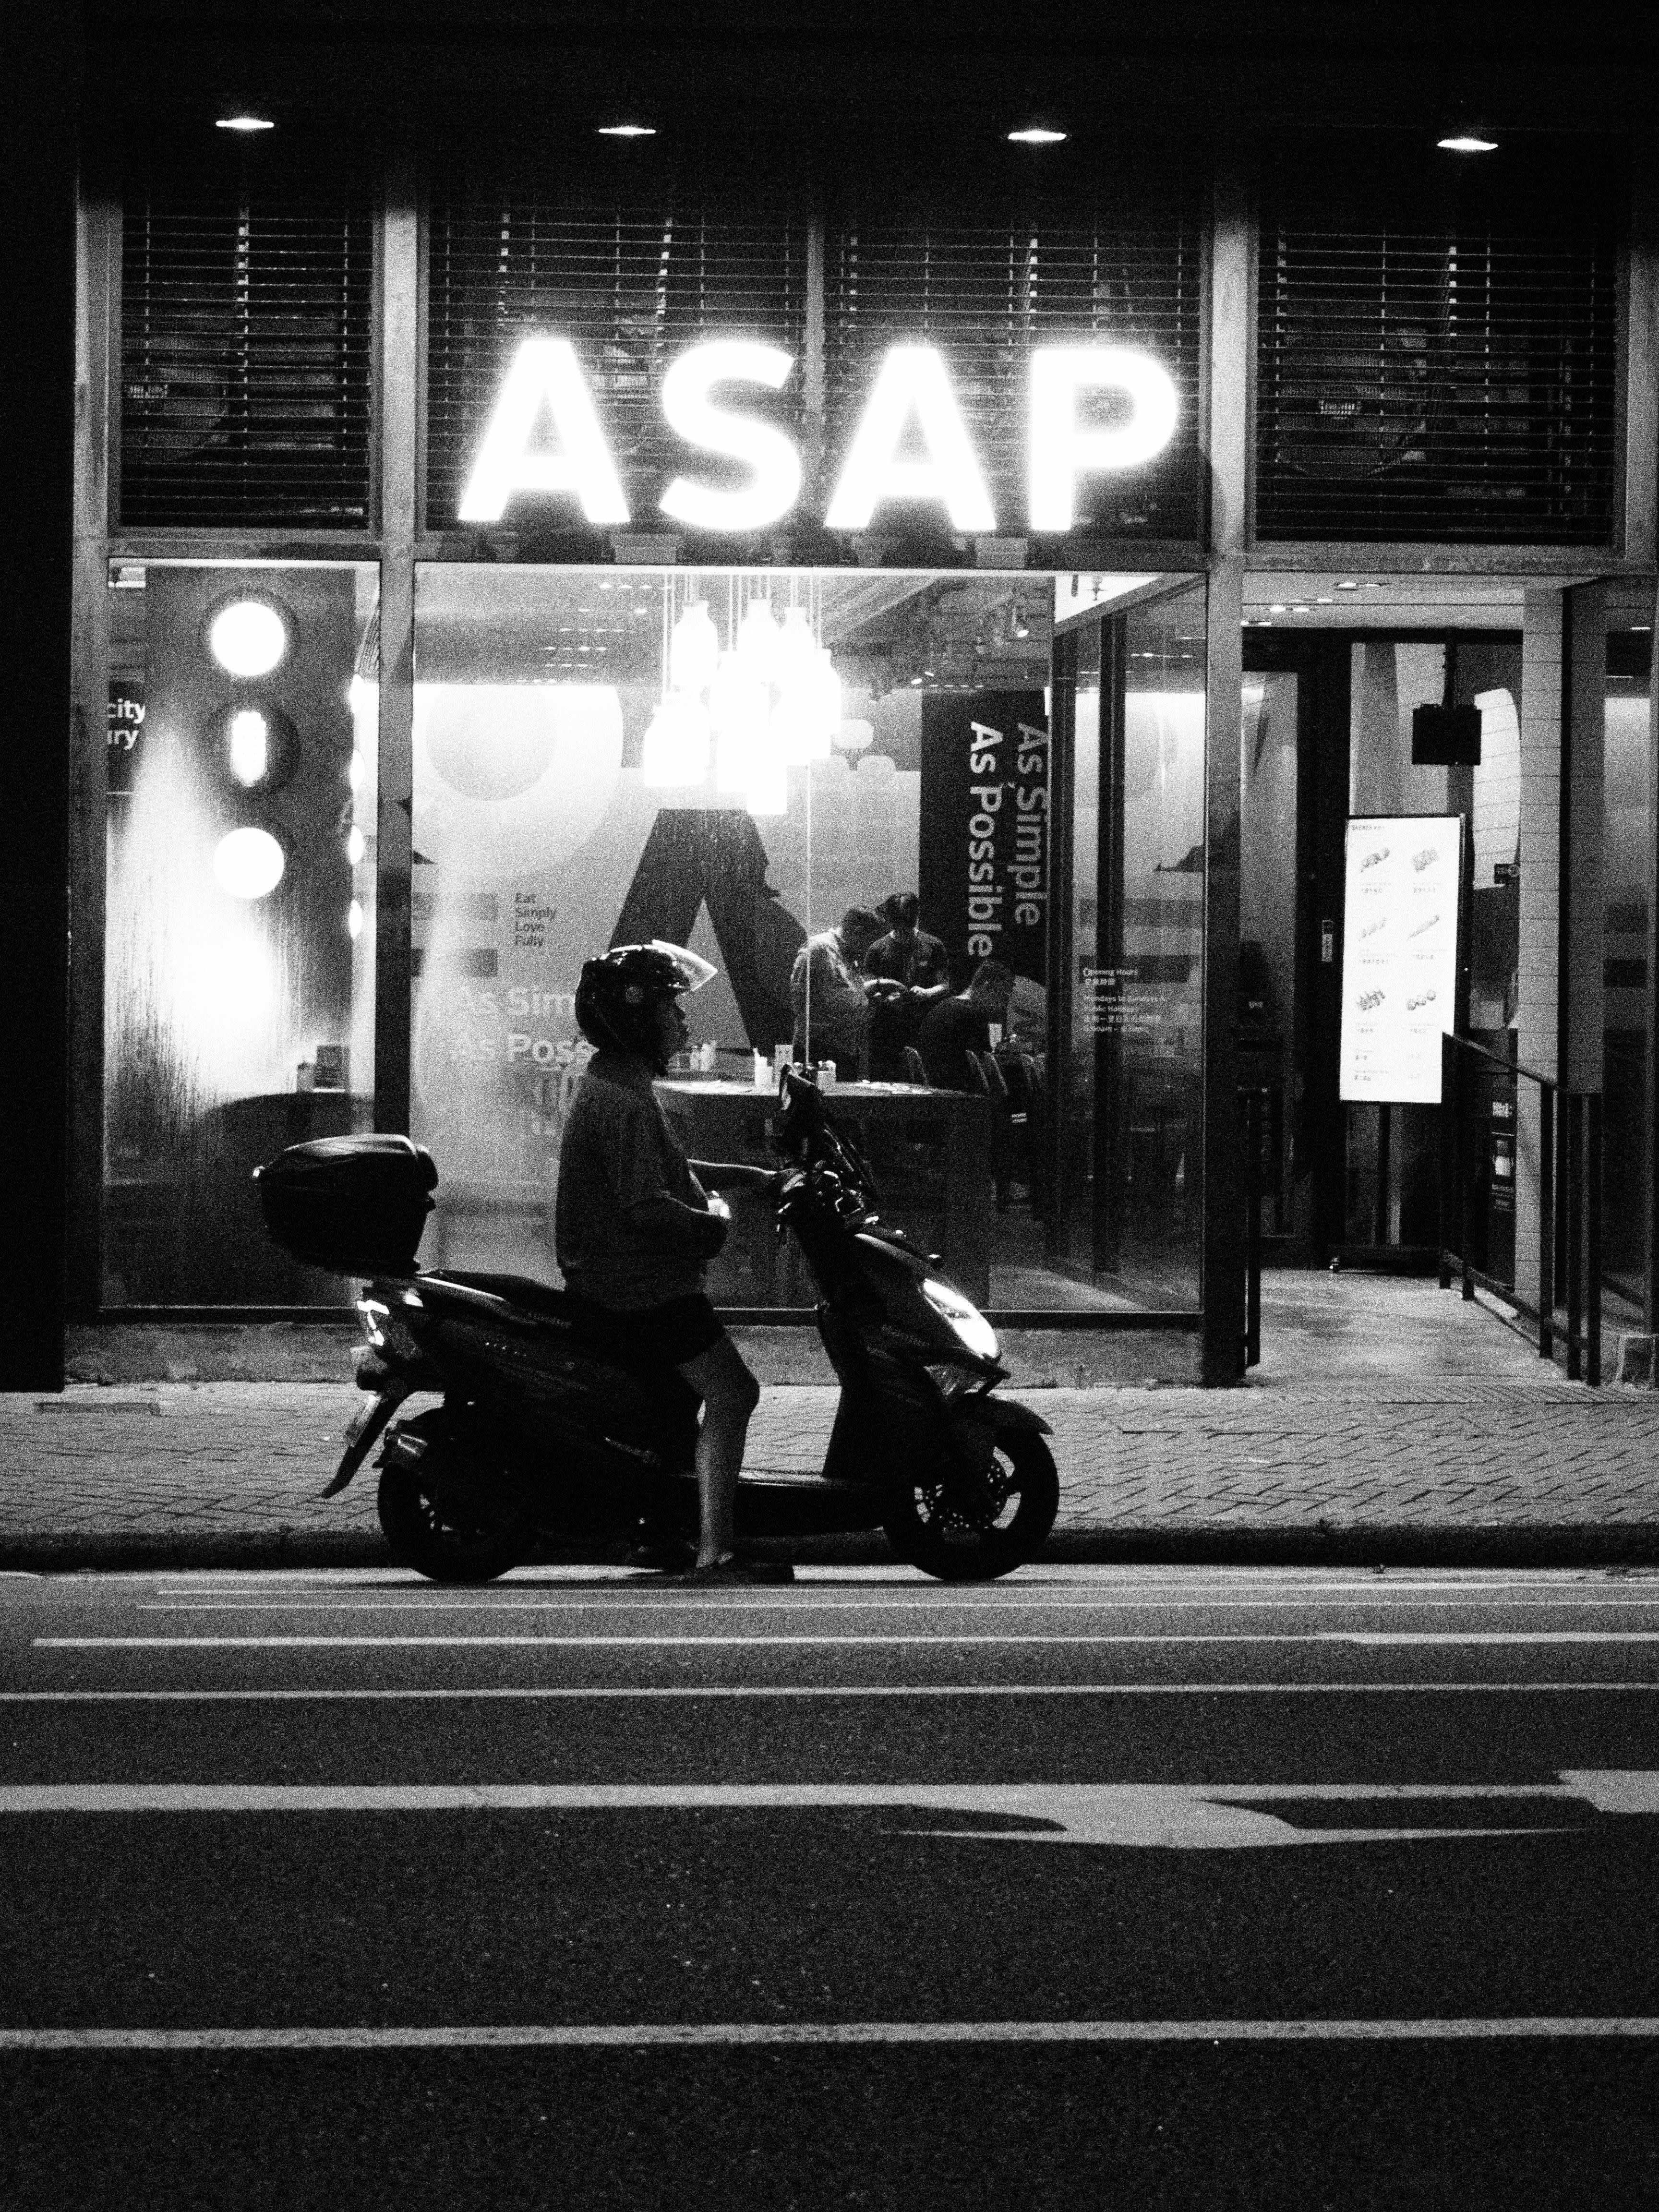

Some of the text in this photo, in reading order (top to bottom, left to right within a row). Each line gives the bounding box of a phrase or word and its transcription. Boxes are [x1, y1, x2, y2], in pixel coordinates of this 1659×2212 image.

[457, 338, 1179, 531] ASAP
[107, 697, 146, 724] city
[1008, 722, 1048, 927] As Simple
[967, 721, 1004, 959] As Possible
[515, 892, 537, 904] Eat
[515, 906, 557, 921] Simply
[515, 921, 545, 932] Love
[515, 935, 544, 949] Fully
[1082, 967, 1115, 977] Opening
[457, 986, 497, 1016] As
[451, 1033, 495, 1061] As
